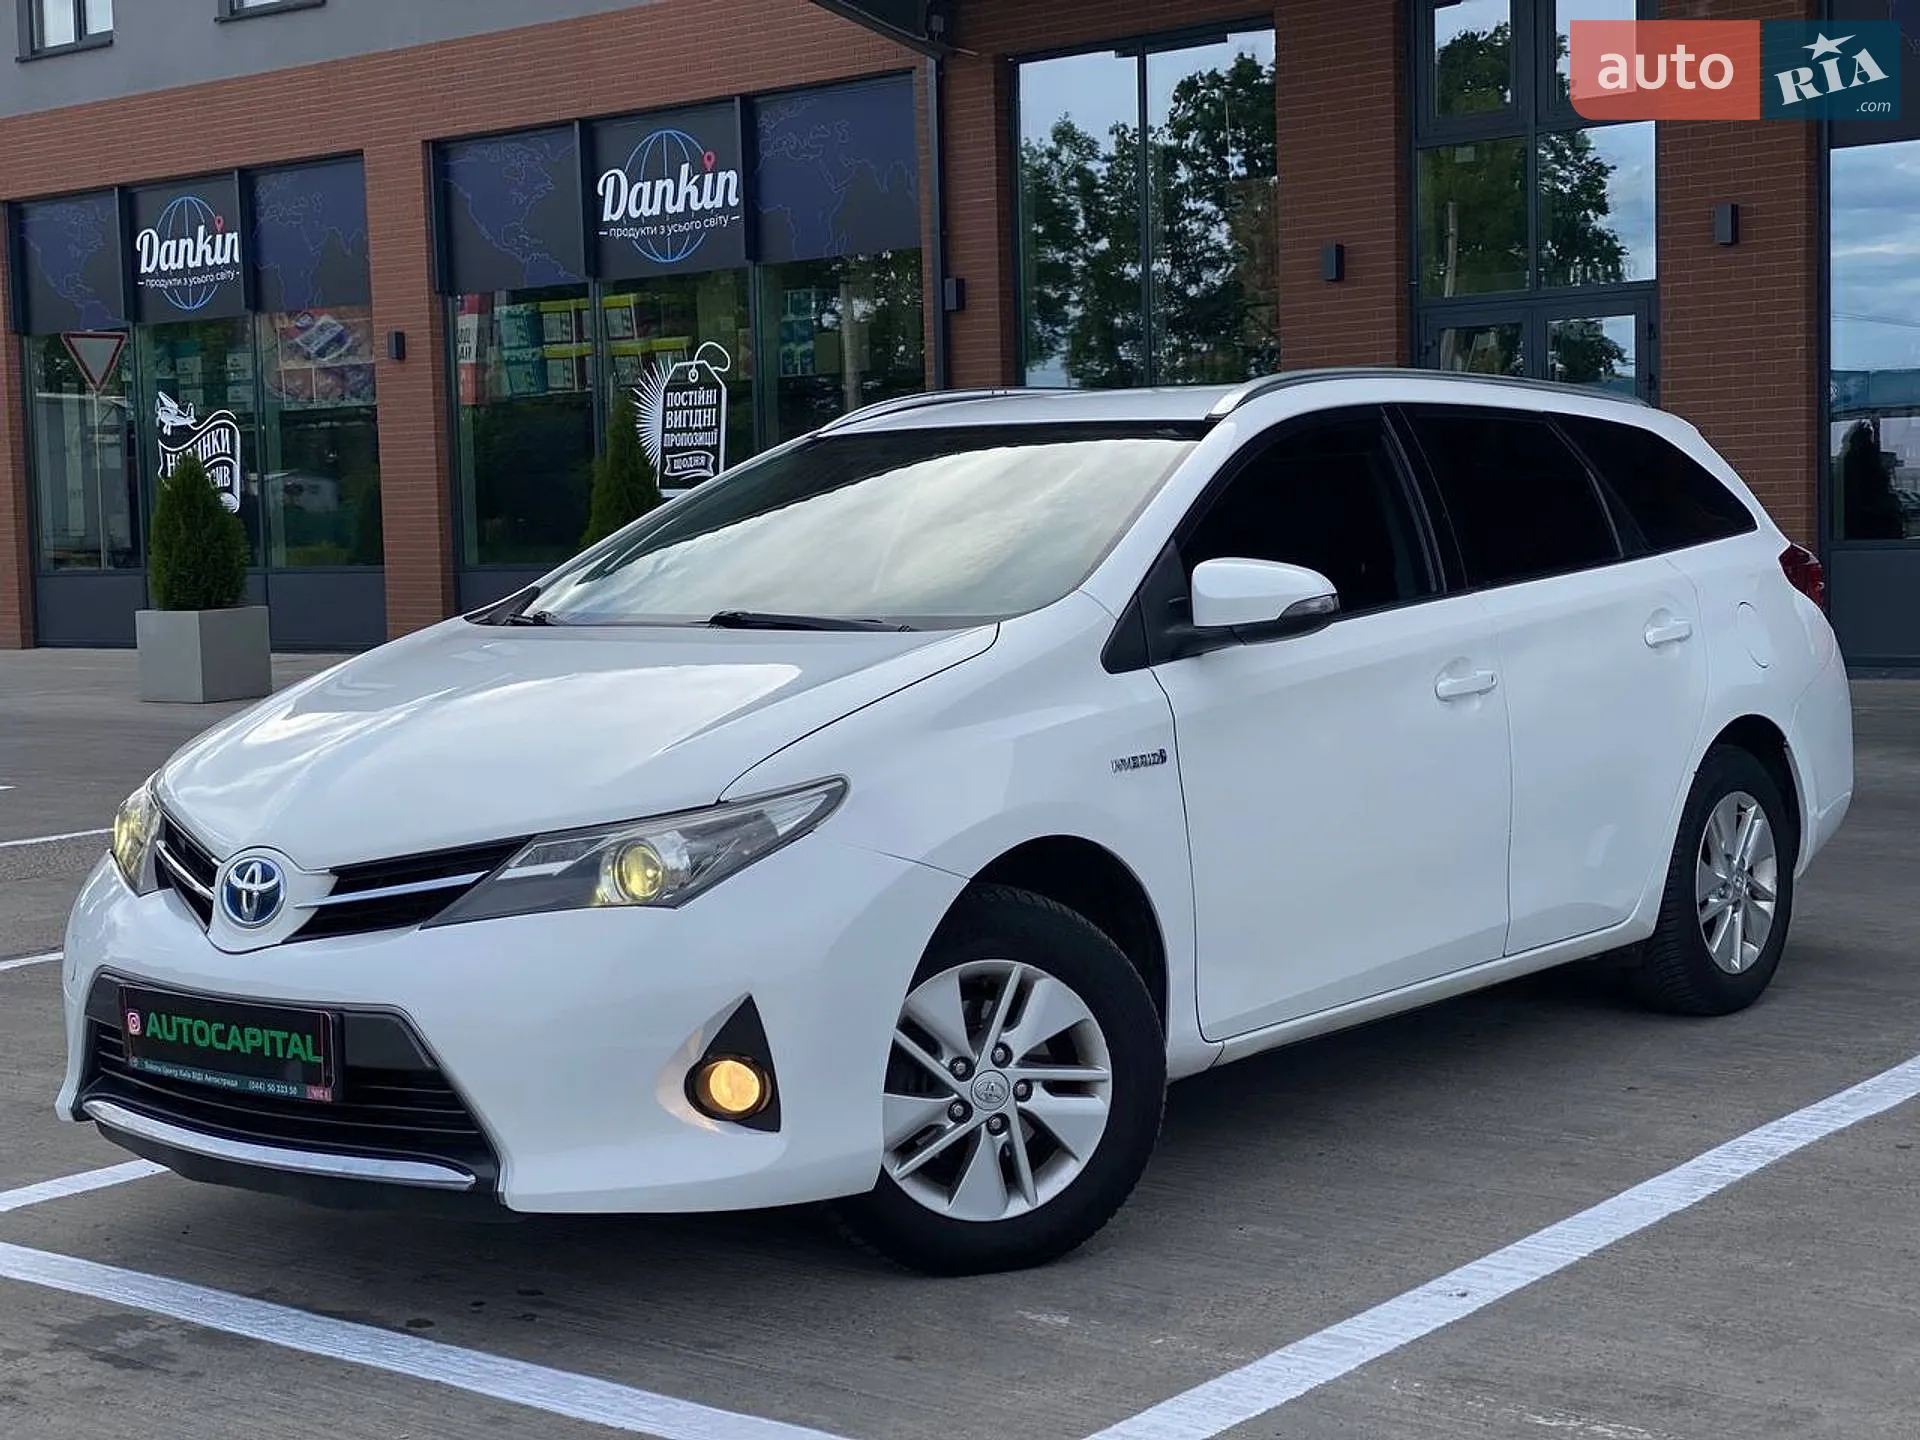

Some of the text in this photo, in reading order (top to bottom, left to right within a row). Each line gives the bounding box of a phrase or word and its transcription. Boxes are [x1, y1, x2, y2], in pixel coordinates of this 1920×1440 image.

[597, 162, 740, 222] Dankin
[609, 213, 730, 239] продукти з усього світу
[136, 224, 240, 274] Dankin
[145, 278, 182, 289] продукти
[188, 273, 214, 287] усього
[666, 386, 717, 408] ПОСТІЙНІ
[665, 408, 717, 430] ВИГІДНІ
[663, 428, 719, 447] ПРОПОЗИЦІЇ
[145, 1011, 324, 1064] AUTOCAPITAL
